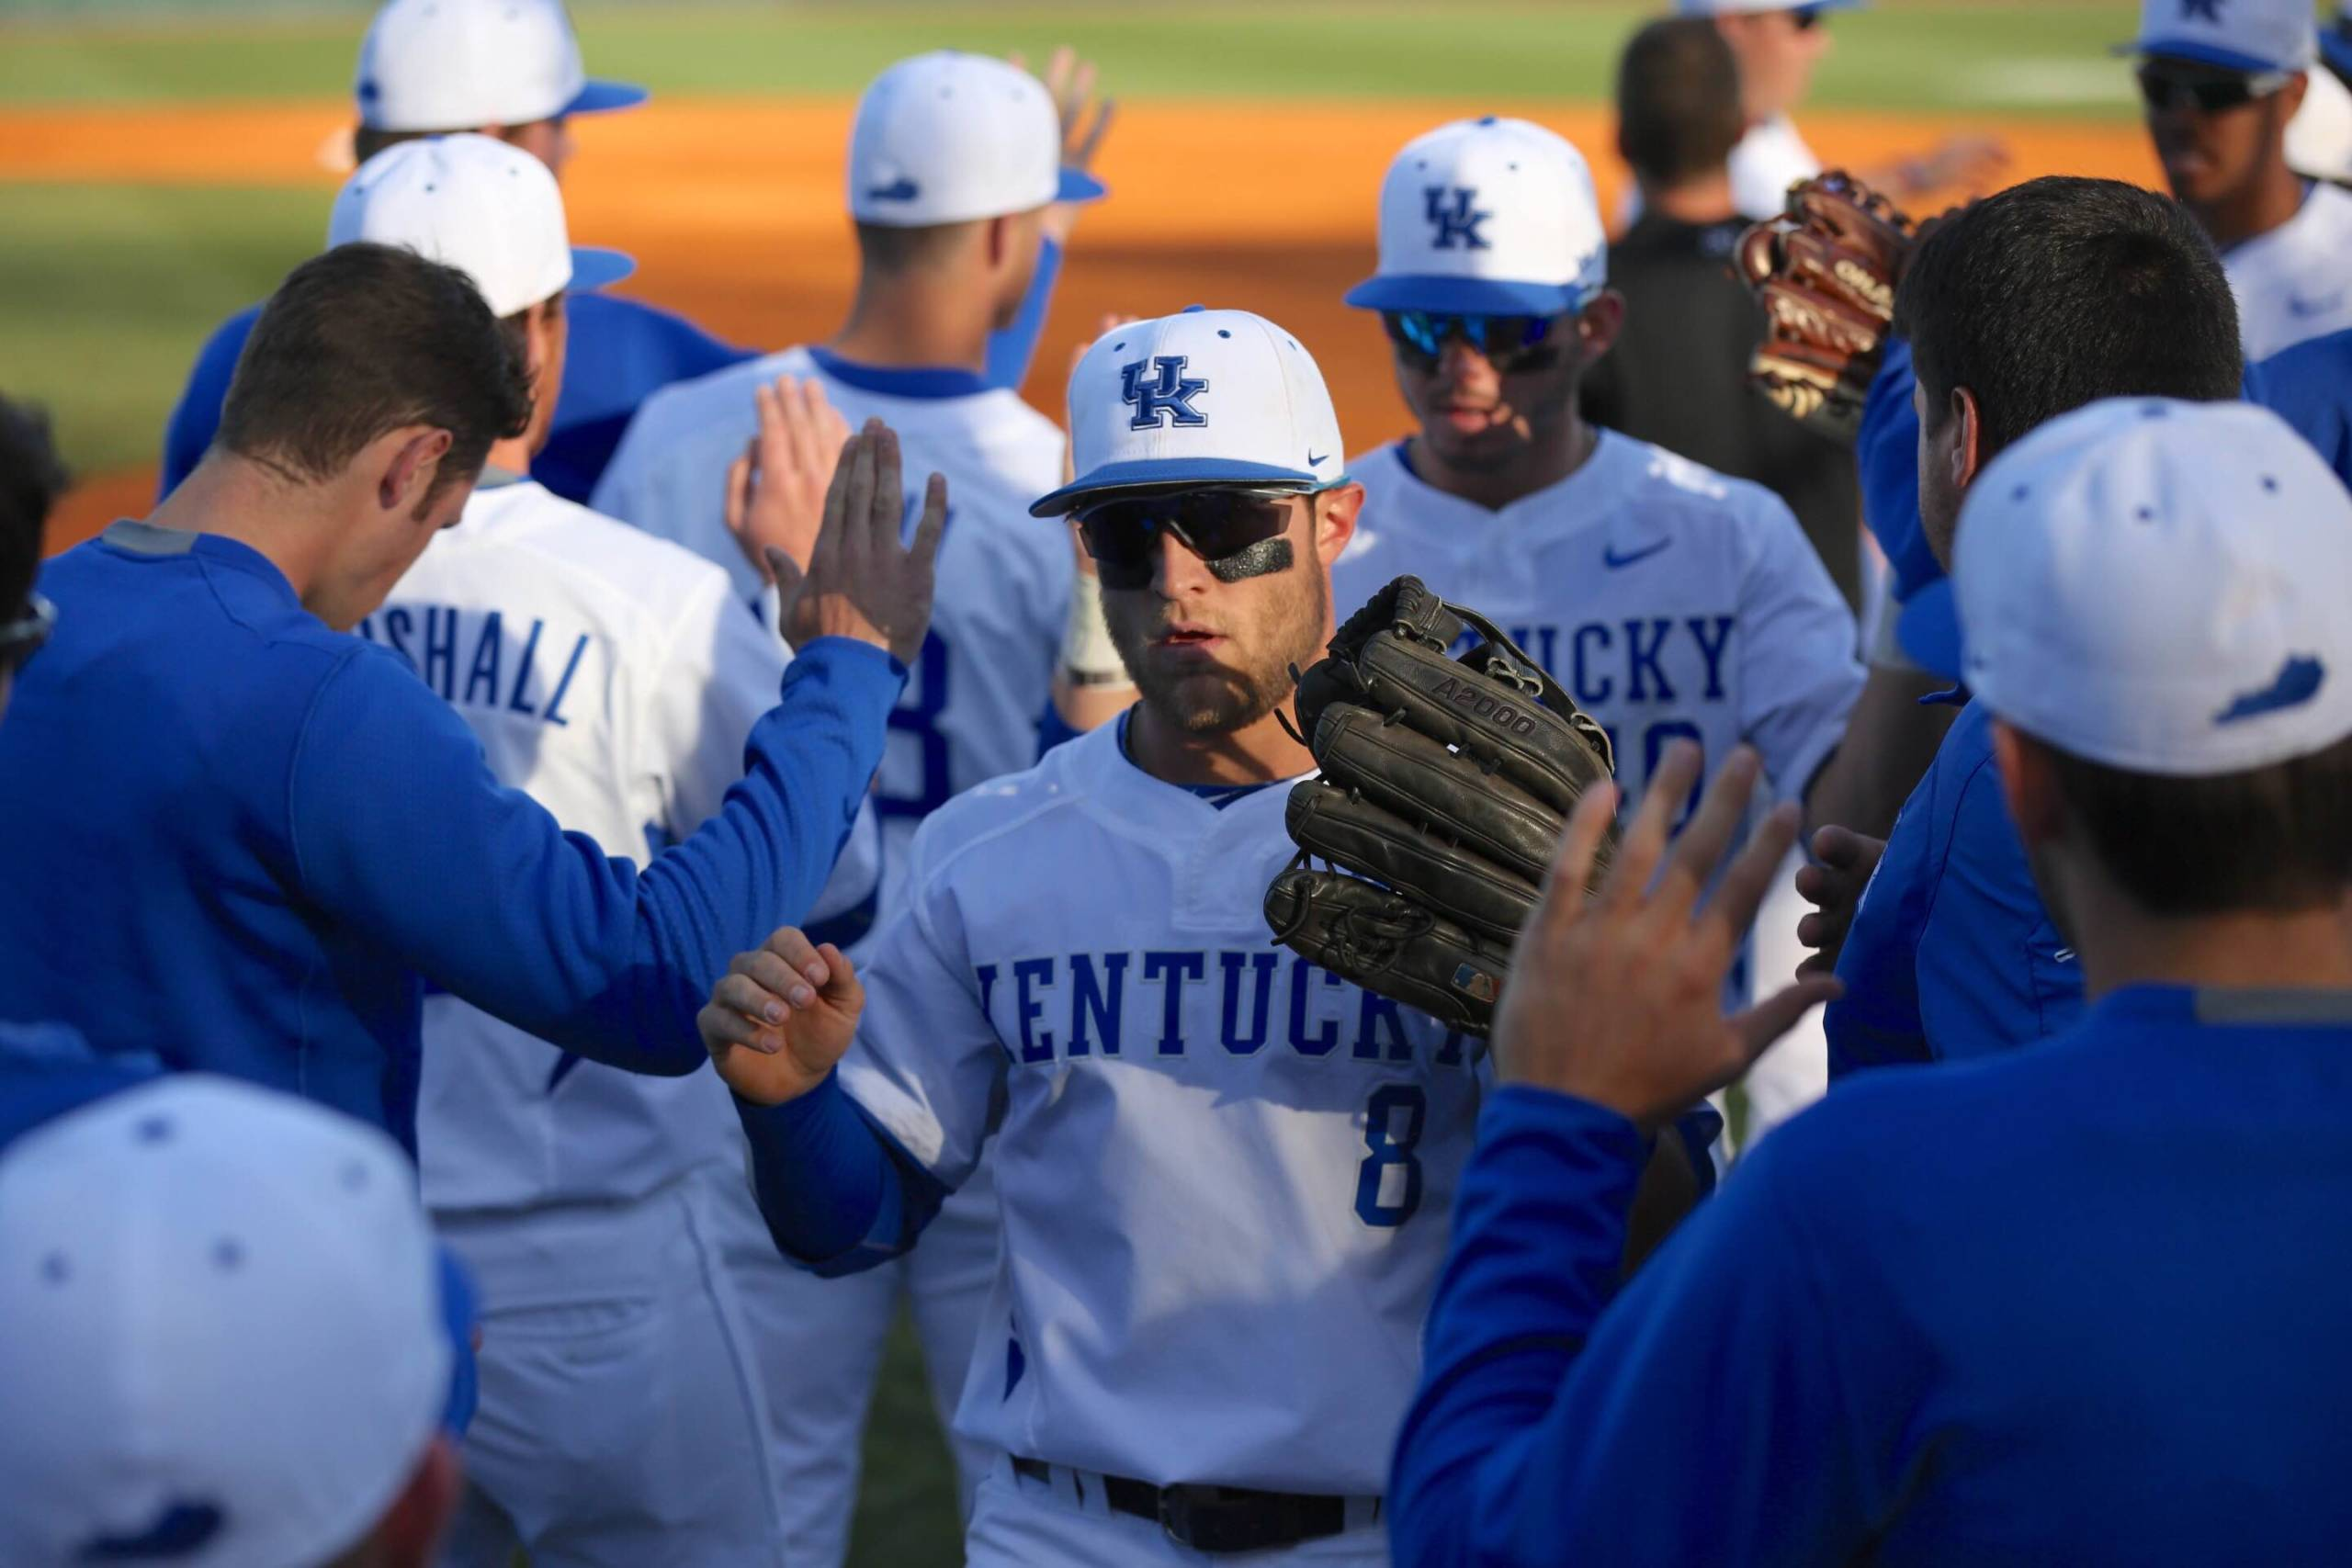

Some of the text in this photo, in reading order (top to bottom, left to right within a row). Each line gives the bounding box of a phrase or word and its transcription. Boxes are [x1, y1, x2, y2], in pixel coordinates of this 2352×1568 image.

[1121, 355, 1209, 431] UK
[361, 606, 589, 727] SHALL
[1432, 677, 1537, 735] A2000
[1354, 1083, 1427, 1228] 8
